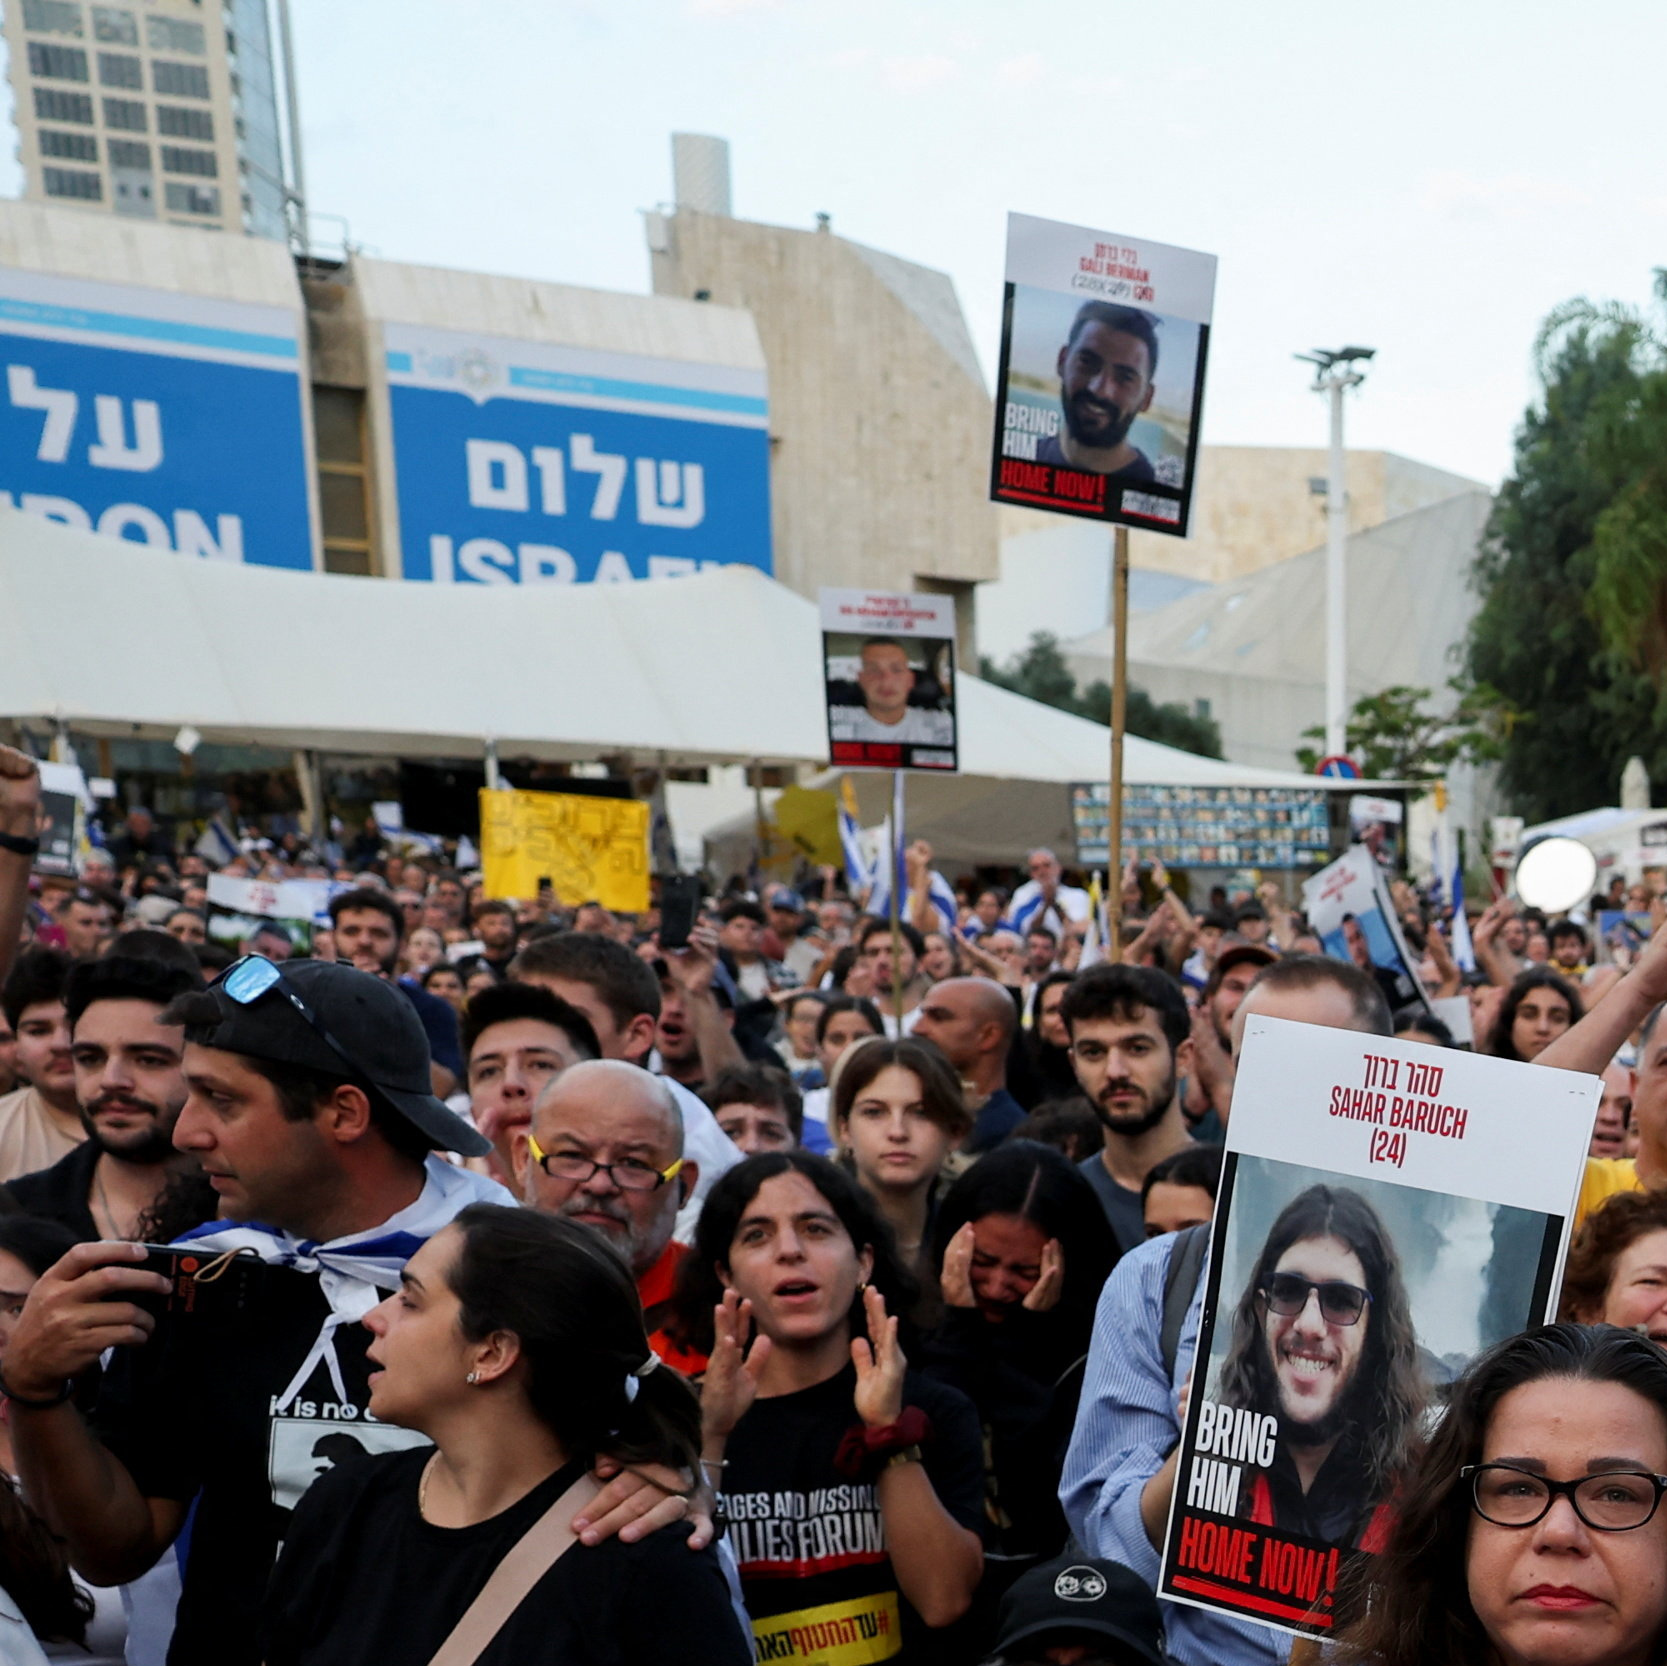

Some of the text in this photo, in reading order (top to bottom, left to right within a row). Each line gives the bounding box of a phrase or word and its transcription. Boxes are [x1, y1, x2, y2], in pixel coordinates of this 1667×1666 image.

[7, 364, 164, 472] על
[1004, 403, 1060, 437] BRING
[1002, 430, 1038, 461] HIM
[466, 432, 705, 528] שלום
[1000, 460, 1105, 503] HOME NOW!
[430, 534, 721, 585] ISRA
[1363, 1054, 1444, 1098] סהר ברוך
[1329, 1086, 1468, 1139] SAHAR BARUCH
[1369, 1128, 1408, 1168] (24)
[294, 1396, 317, 1417] is
[1195, 1401, 1278, 1468] BRING
[774, 1490, 805, 1520] AND
[1186, 1455, 1242, 1517] HIM
[731, 1512, 882, 1564] ILIES FORUM
[1178, 1517, 1339, 1607] HOME NOW!
